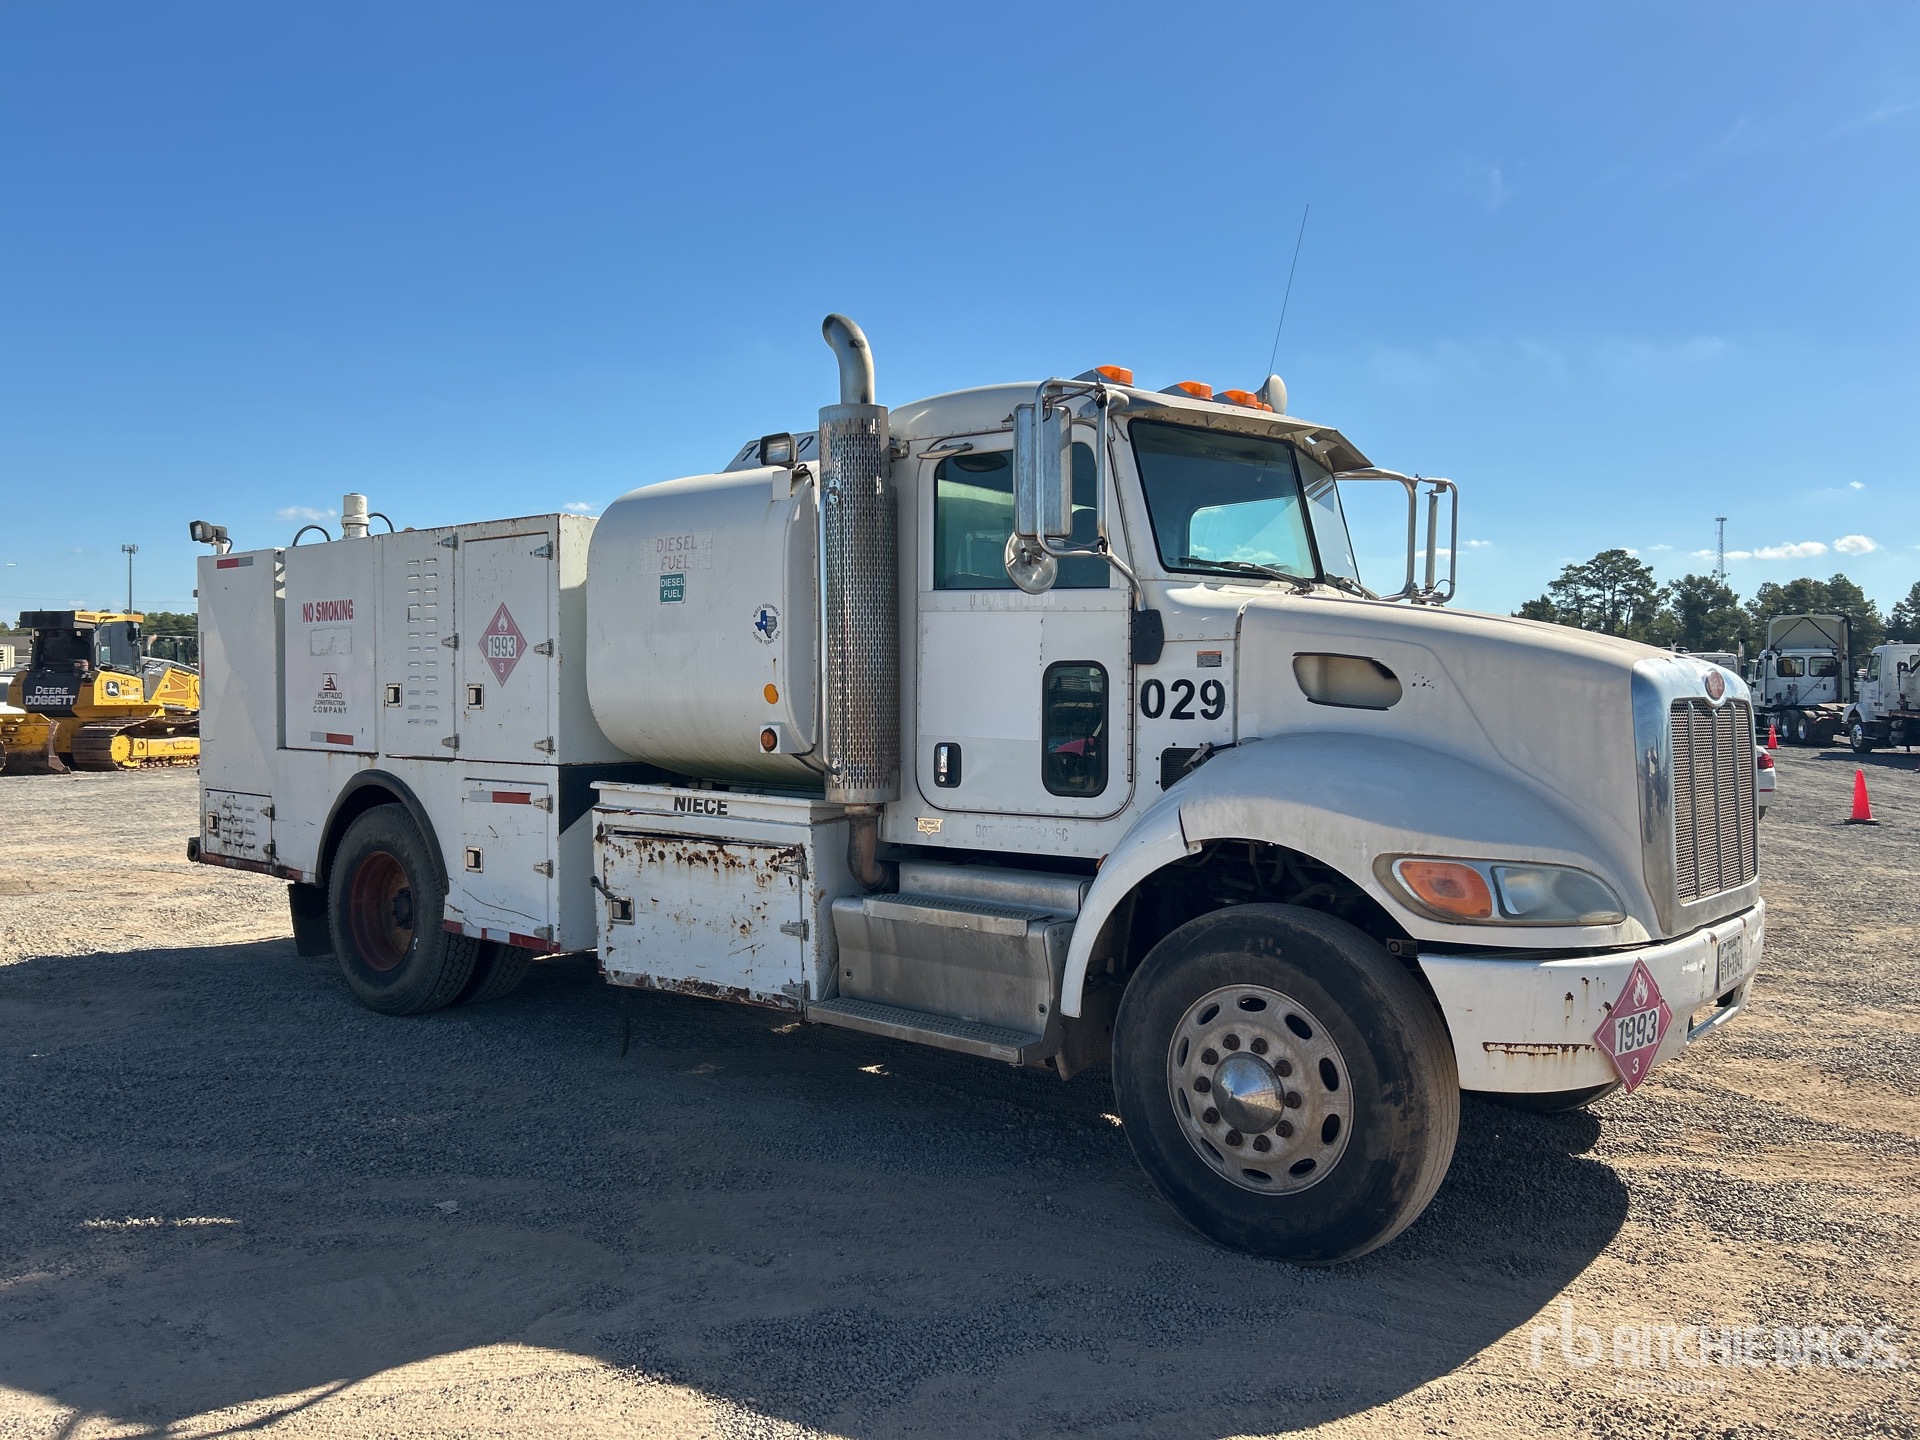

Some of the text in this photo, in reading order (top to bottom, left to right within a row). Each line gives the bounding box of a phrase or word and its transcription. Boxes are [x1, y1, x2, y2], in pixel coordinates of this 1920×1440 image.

[656, 534, 698, 553] DIESEL
[661, 554, 691, 571] FUEL
[660, 577, 685, 588] DIESEL
[663, 589, 682, 599] FUEL
[303, 599, 354, 623] NO SMOKING
[489, 636, 515, 657] 1993
[499, 662, 505, 673] 3
[35, 685, 69, 695] DEERE
[317, 691, 342, 700] HURTADO
[25, 695, 76, 705] DOGGETT
[1140, 678, 1226, 720] 029
[313, 705, 348, 714] COMPANY
[673, 796, 729, 816] NIECE
[1617, 1009, 1658, 1053] 1993
[1631, 1057, 1640, 1075] 3
